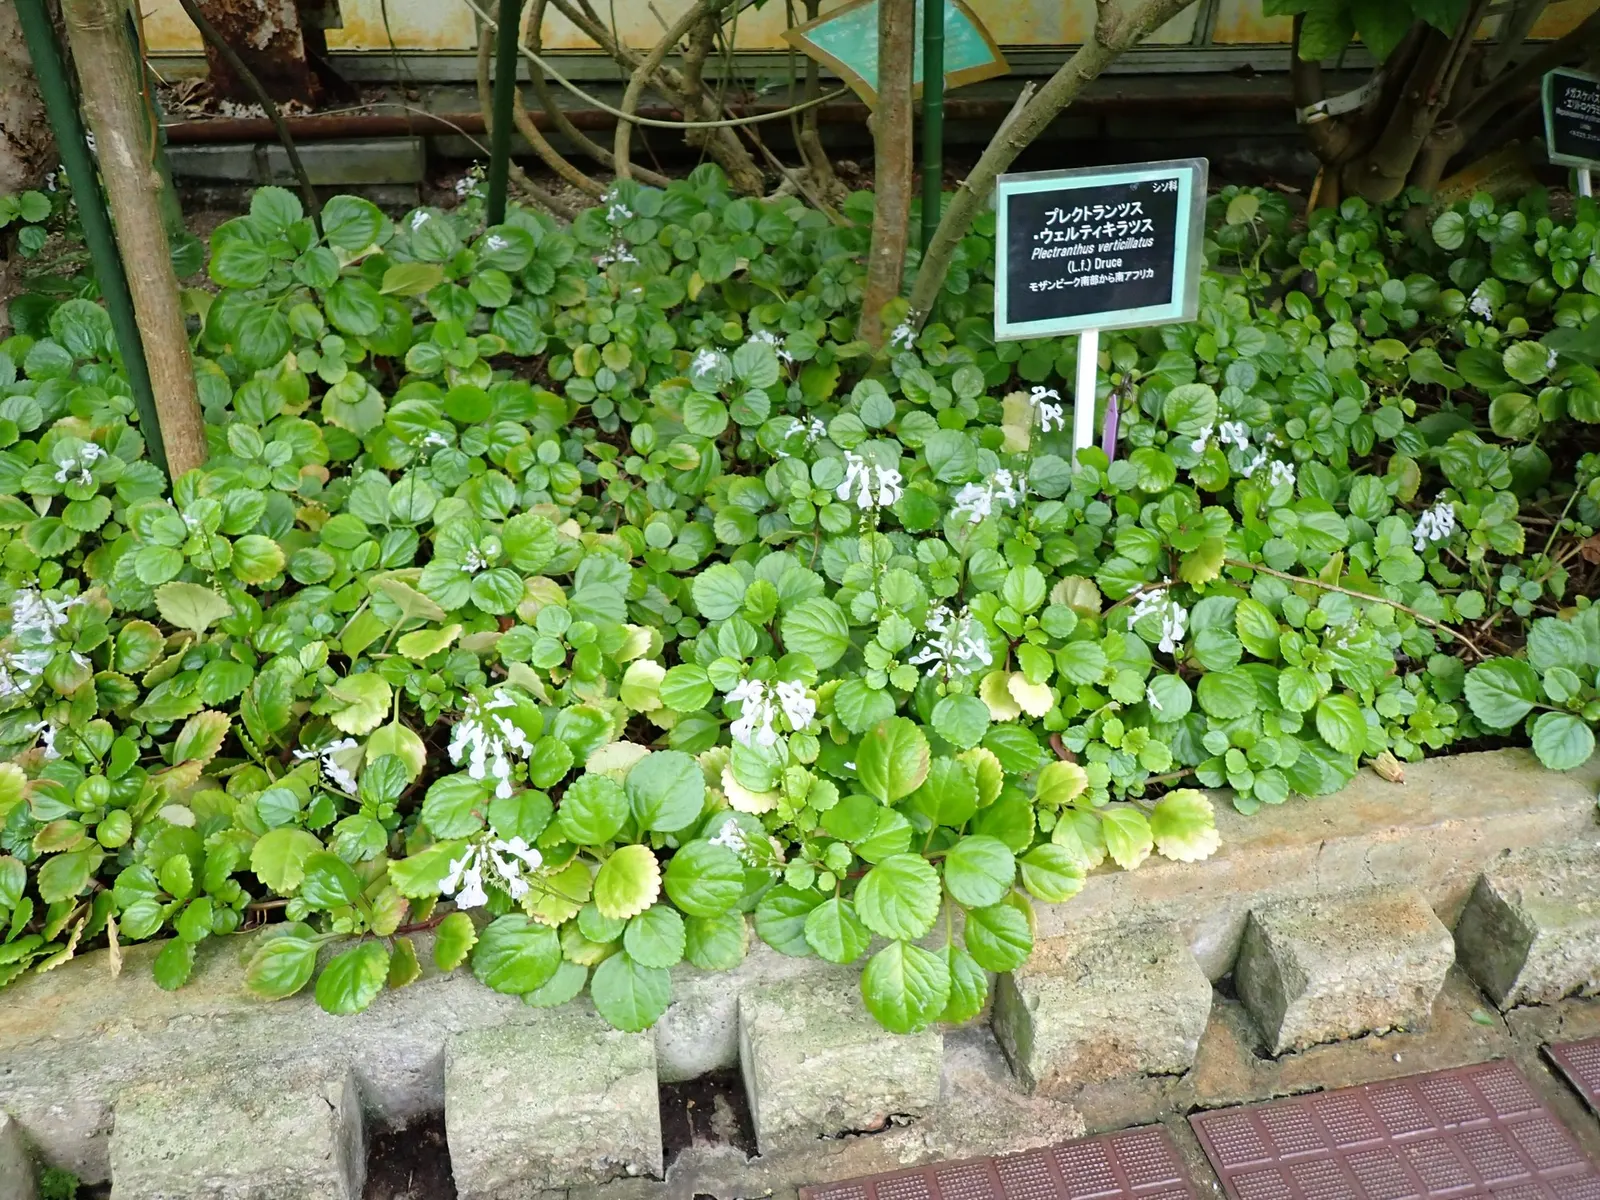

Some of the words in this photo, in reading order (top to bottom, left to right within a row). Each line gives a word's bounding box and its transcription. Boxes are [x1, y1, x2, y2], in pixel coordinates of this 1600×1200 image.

[1152, 180, 1178, 193] シソ科
[1044, 201, 1144, 226] プレクトランツス
[1031, 244, 1094, 261] Plectranthus
[1097, 236, 1154, 254] verticillatus
[1067, 260, 1092, 274] (L.f.)
[1094, 257, 1122, 270] Druce
